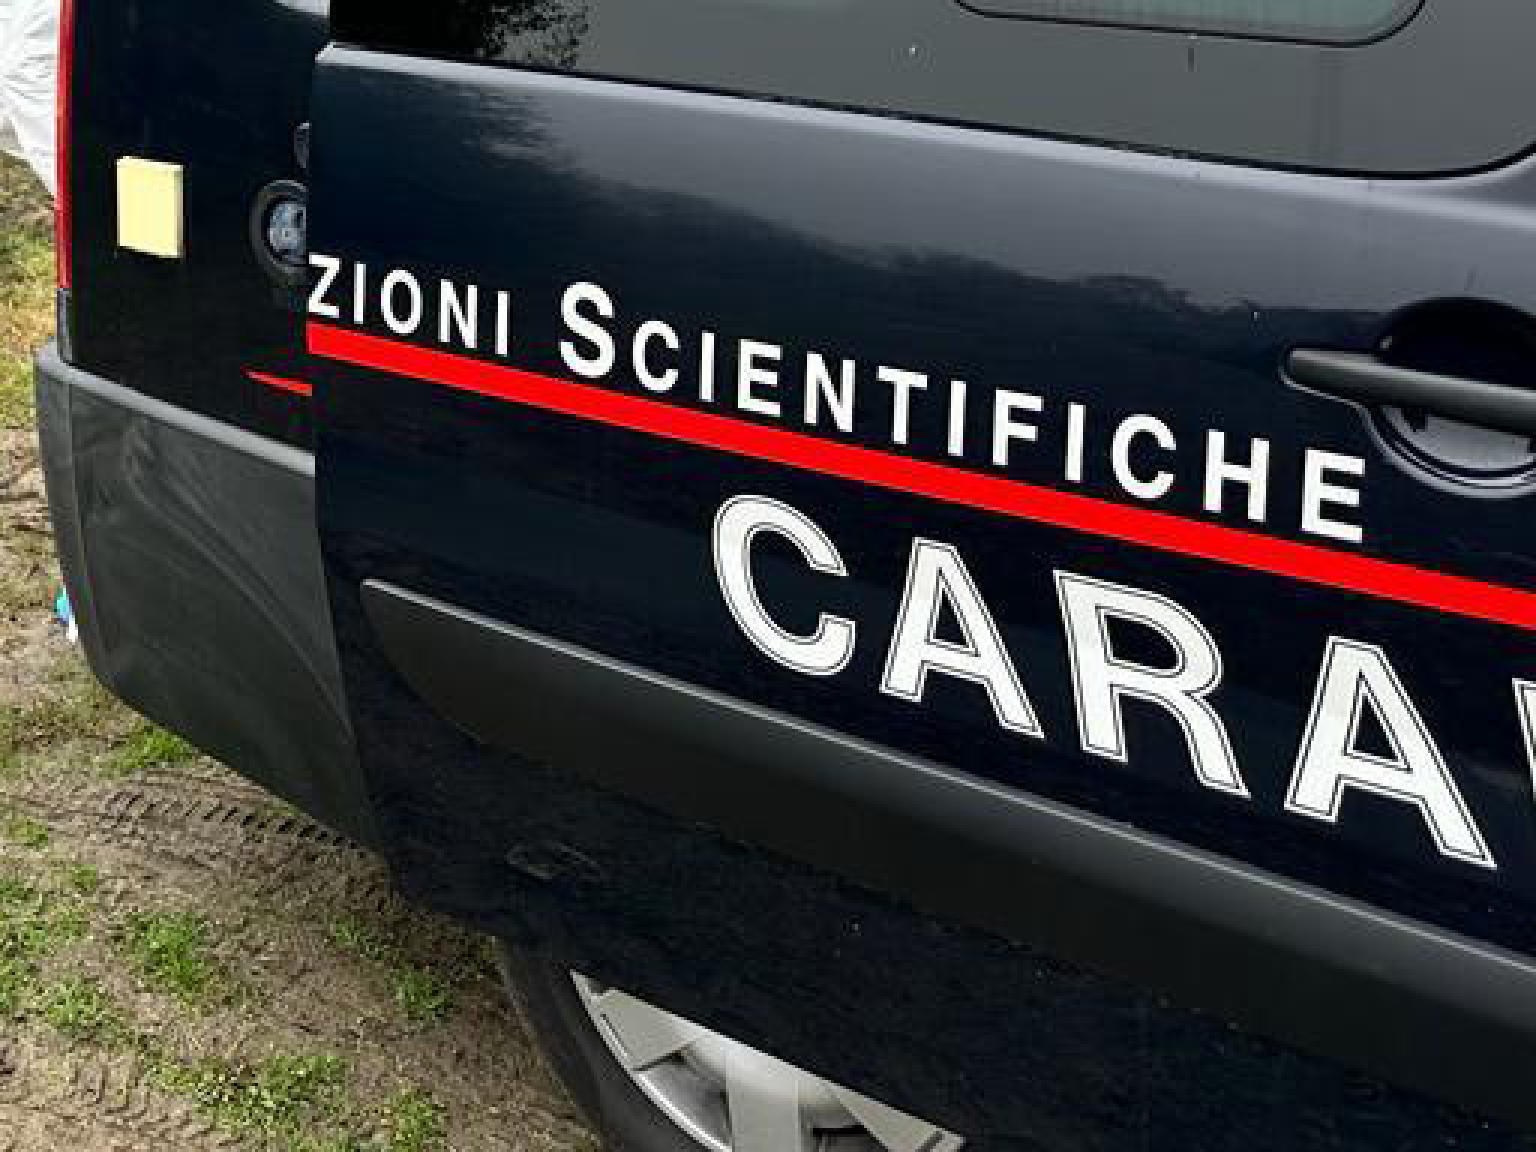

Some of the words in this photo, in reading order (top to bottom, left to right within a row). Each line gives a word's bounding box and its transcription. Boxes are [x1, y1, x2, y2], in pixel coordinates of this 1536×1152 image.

[308, 253, 510, 357] ZIONI
[559, 280, 1367, 545] SCIENTIFICHE
[712, 494, 1536, 870] CARA
